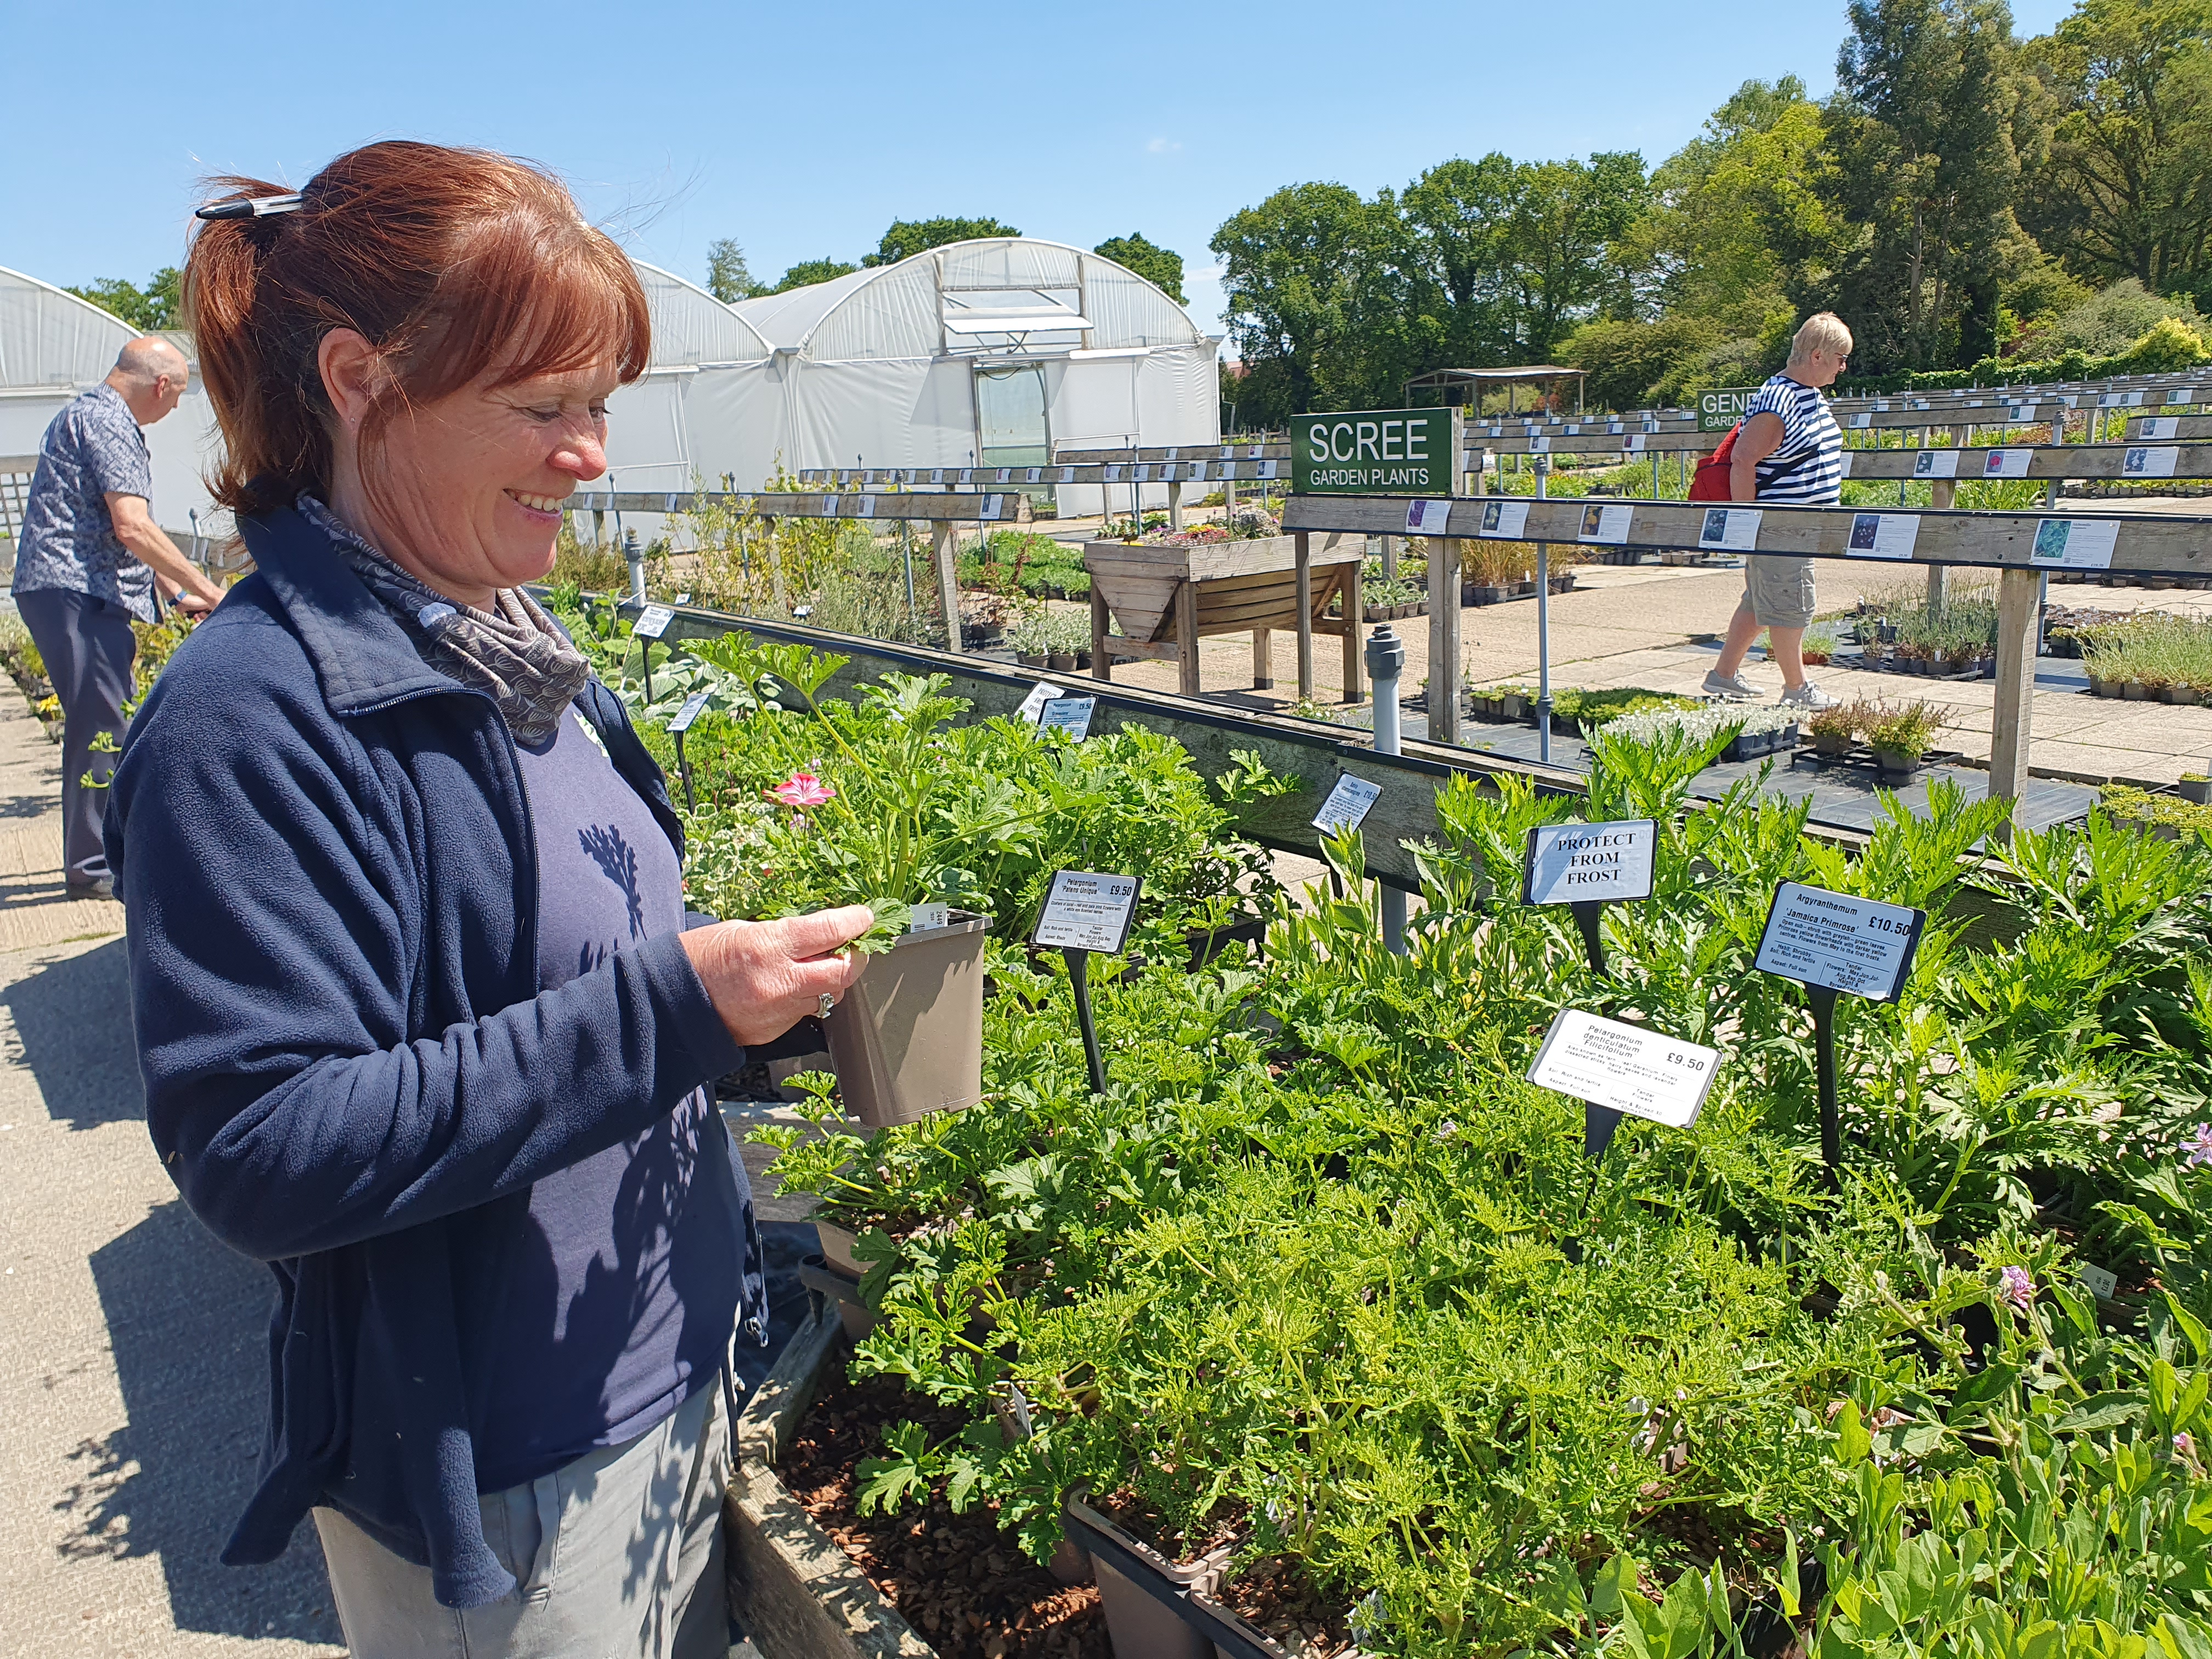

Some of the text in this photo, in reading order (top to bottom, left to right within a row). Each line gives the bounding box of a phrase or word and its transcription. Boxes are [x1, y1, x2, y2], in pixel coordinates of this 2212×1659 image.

[1310, 419, 1429, 462] SCREE
[1311, 468, 1429, 486] GARDEN PLANTS
[1037, 687, 1057, 698] PROTECT
[1027, 704, 1041, 714] FROST
[1558, 833, 1637, 851] PROTECT
[1570, 851, 1620, 867] FROM
[1066, 878, 1097, 888] Pelargonium
[1566, 869, 1622, 884] FROST
[1109, 885, 1132, 896] £9.50
[1796, 893, 1857, 915] Argyranthemum
[1868, 916, 1911, 936] £10.50
[1798, 935, 1816, 944] Flowers
[1829, 943, 1839, 951] May
[1802, 956, 1815, 964] fertile
[1846, 962, 1863, 971] Tender
[1583, 1032, 1639, 1053] denticulatum
[1588, 1025, 1642, 1046] Pelargonium
[1666, 1052, 1704, 1070] £9.50
